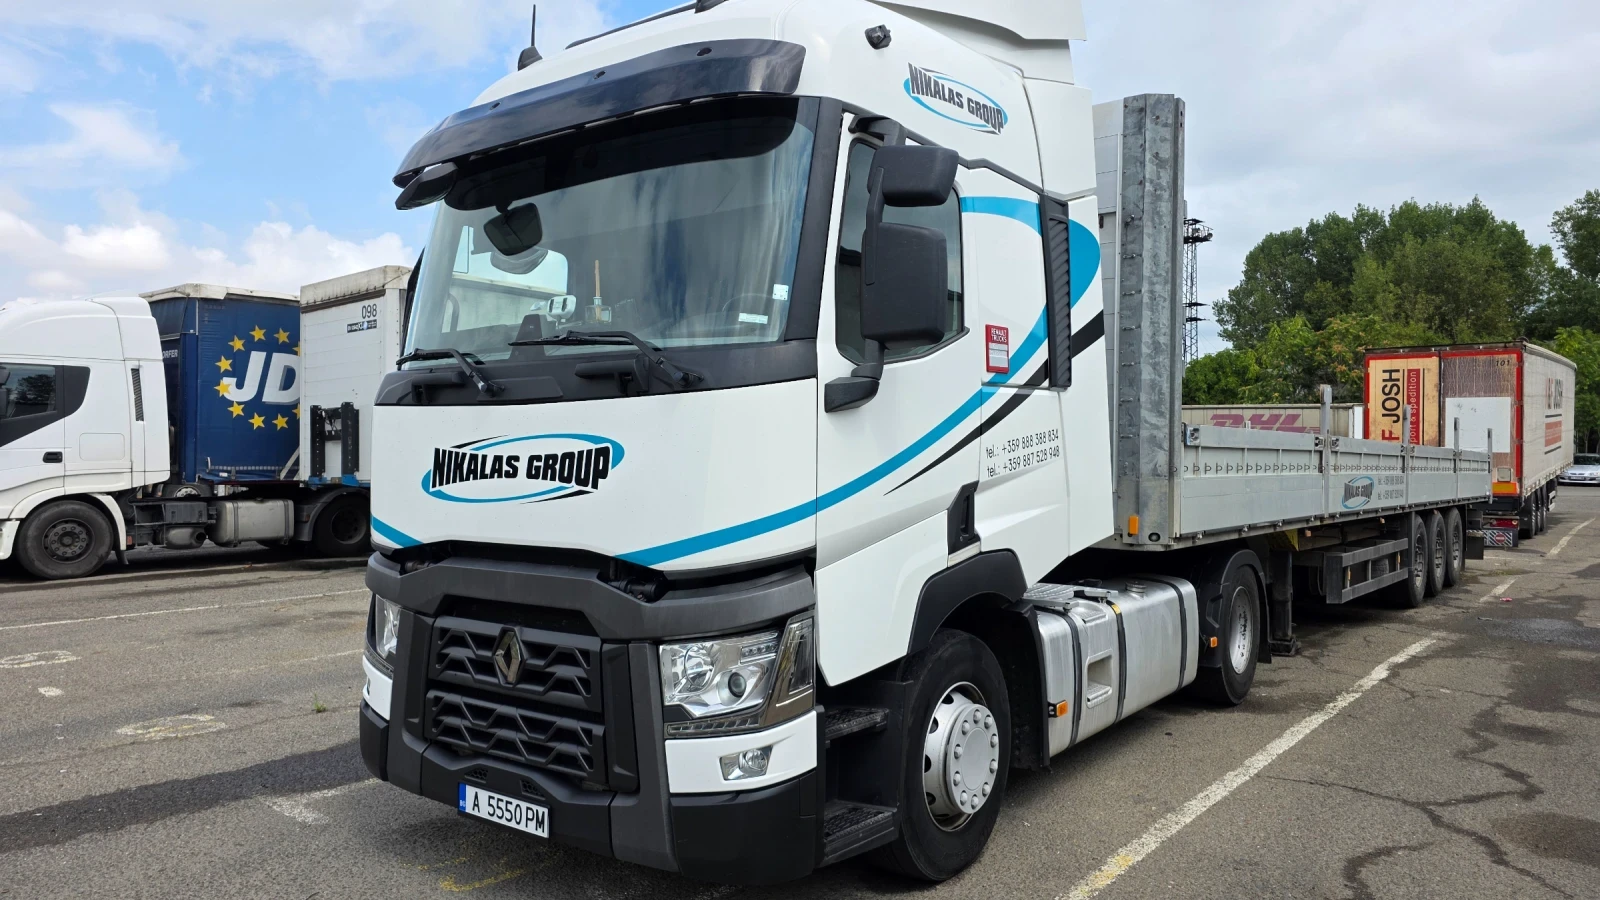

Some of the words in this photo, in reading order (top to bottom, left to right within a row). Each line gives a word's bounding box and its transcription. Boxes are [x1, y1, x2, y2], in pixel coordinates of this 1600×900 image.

[908, 62, 964, 109] NIKALAS
[967, 97, 1004, 134] GROUP
[362, 304, 377, 319] 098
[1382, 369, 1401, 424] JOSH
[1002, 438, 1020, 454] +359
[1022, 435, 1034, 449] 888
[1035, 431, 1047, 446] 388
[1048, 429, 1059, 442] 834
[1003, 456, 1021, 472] +359
[1023, 452, 1035, 467] 887
[1037, 449, 1048, 463] 528
[431, 447, 520, 489] NIKALAS
[526, 446, 611, 490] GROUP
[472, 791, 481, 814] A
[487, 795, 523, 826] 5550
[525, 806, 545, 834] PM
